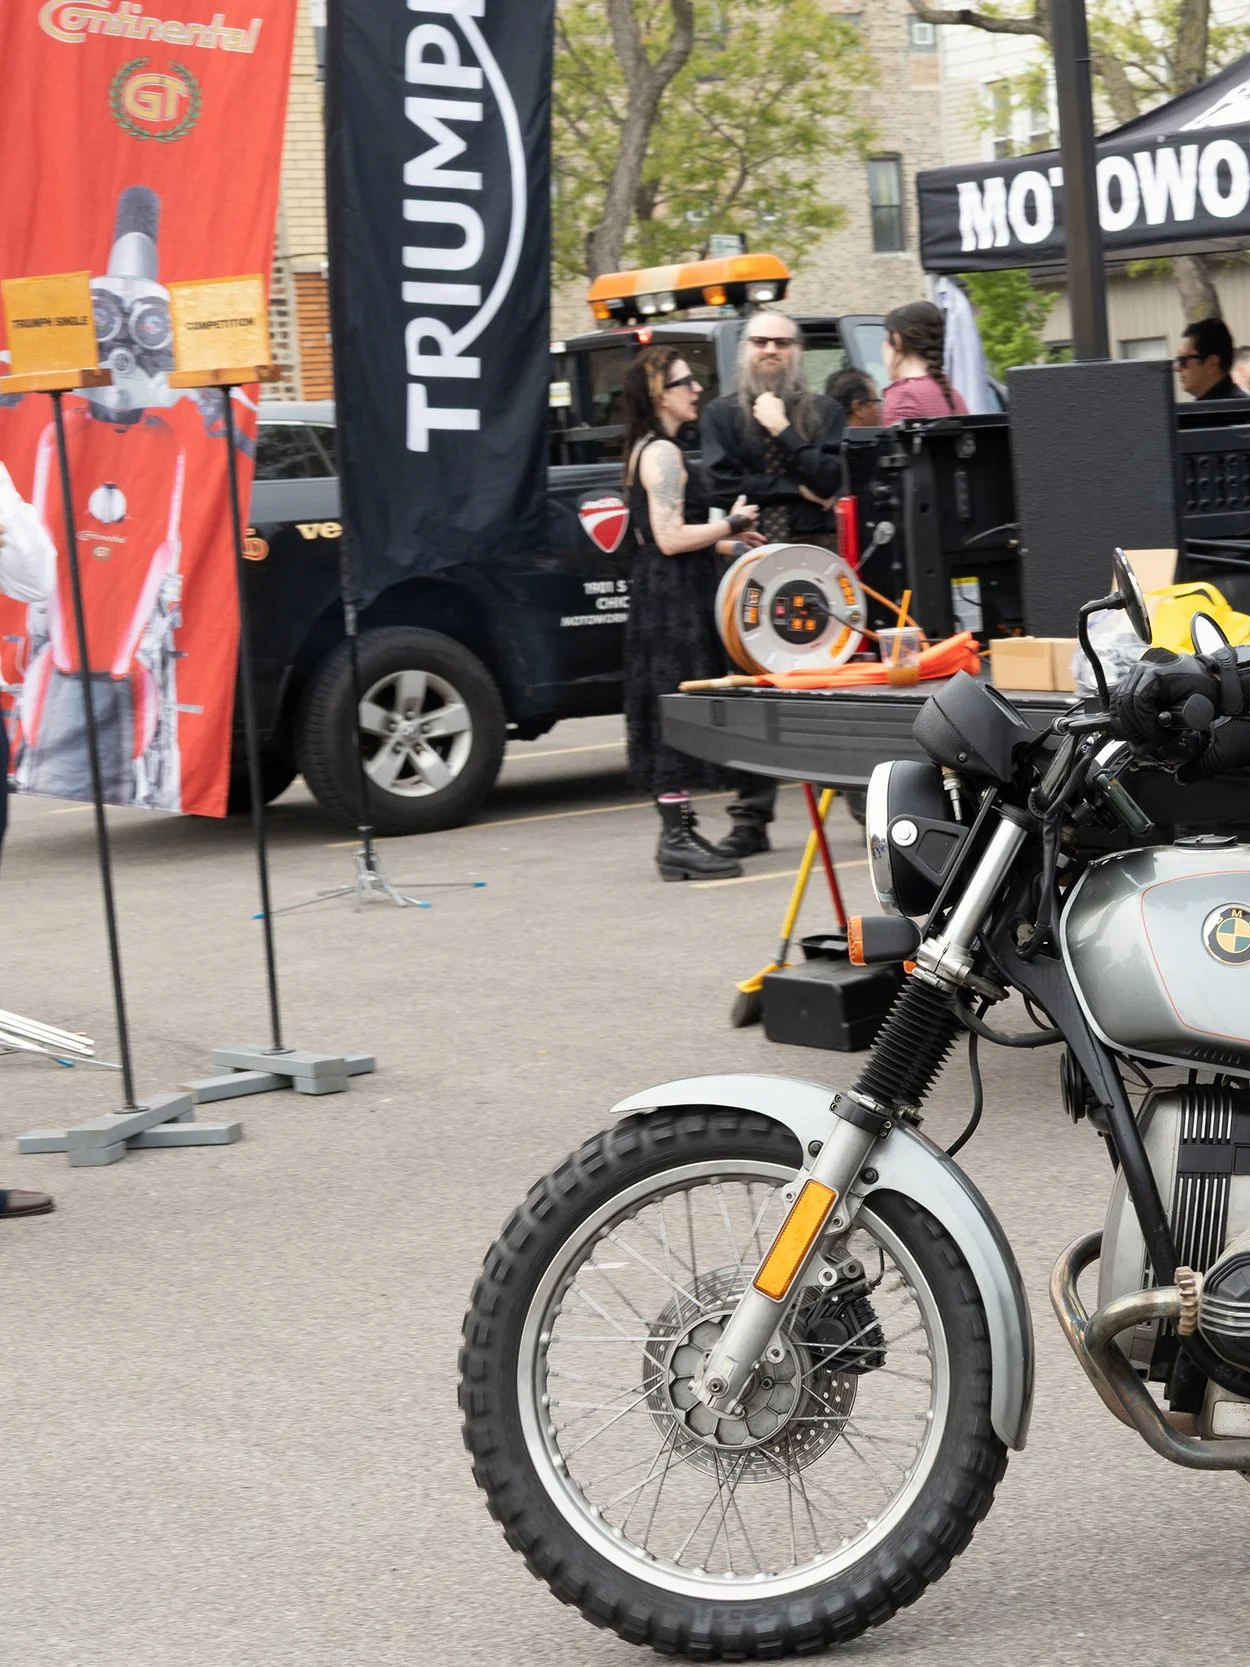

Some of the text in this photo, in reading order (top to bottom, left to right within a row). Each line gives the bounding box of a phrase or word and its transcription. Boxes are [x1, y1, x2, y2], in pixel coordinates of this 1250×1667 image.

[38, 0, 263, 53] Continental
[123, 73, 189, 121] GT
[401, 0, 486, 452] TRIUMP
[595, 596, 632, 610] CHIC
